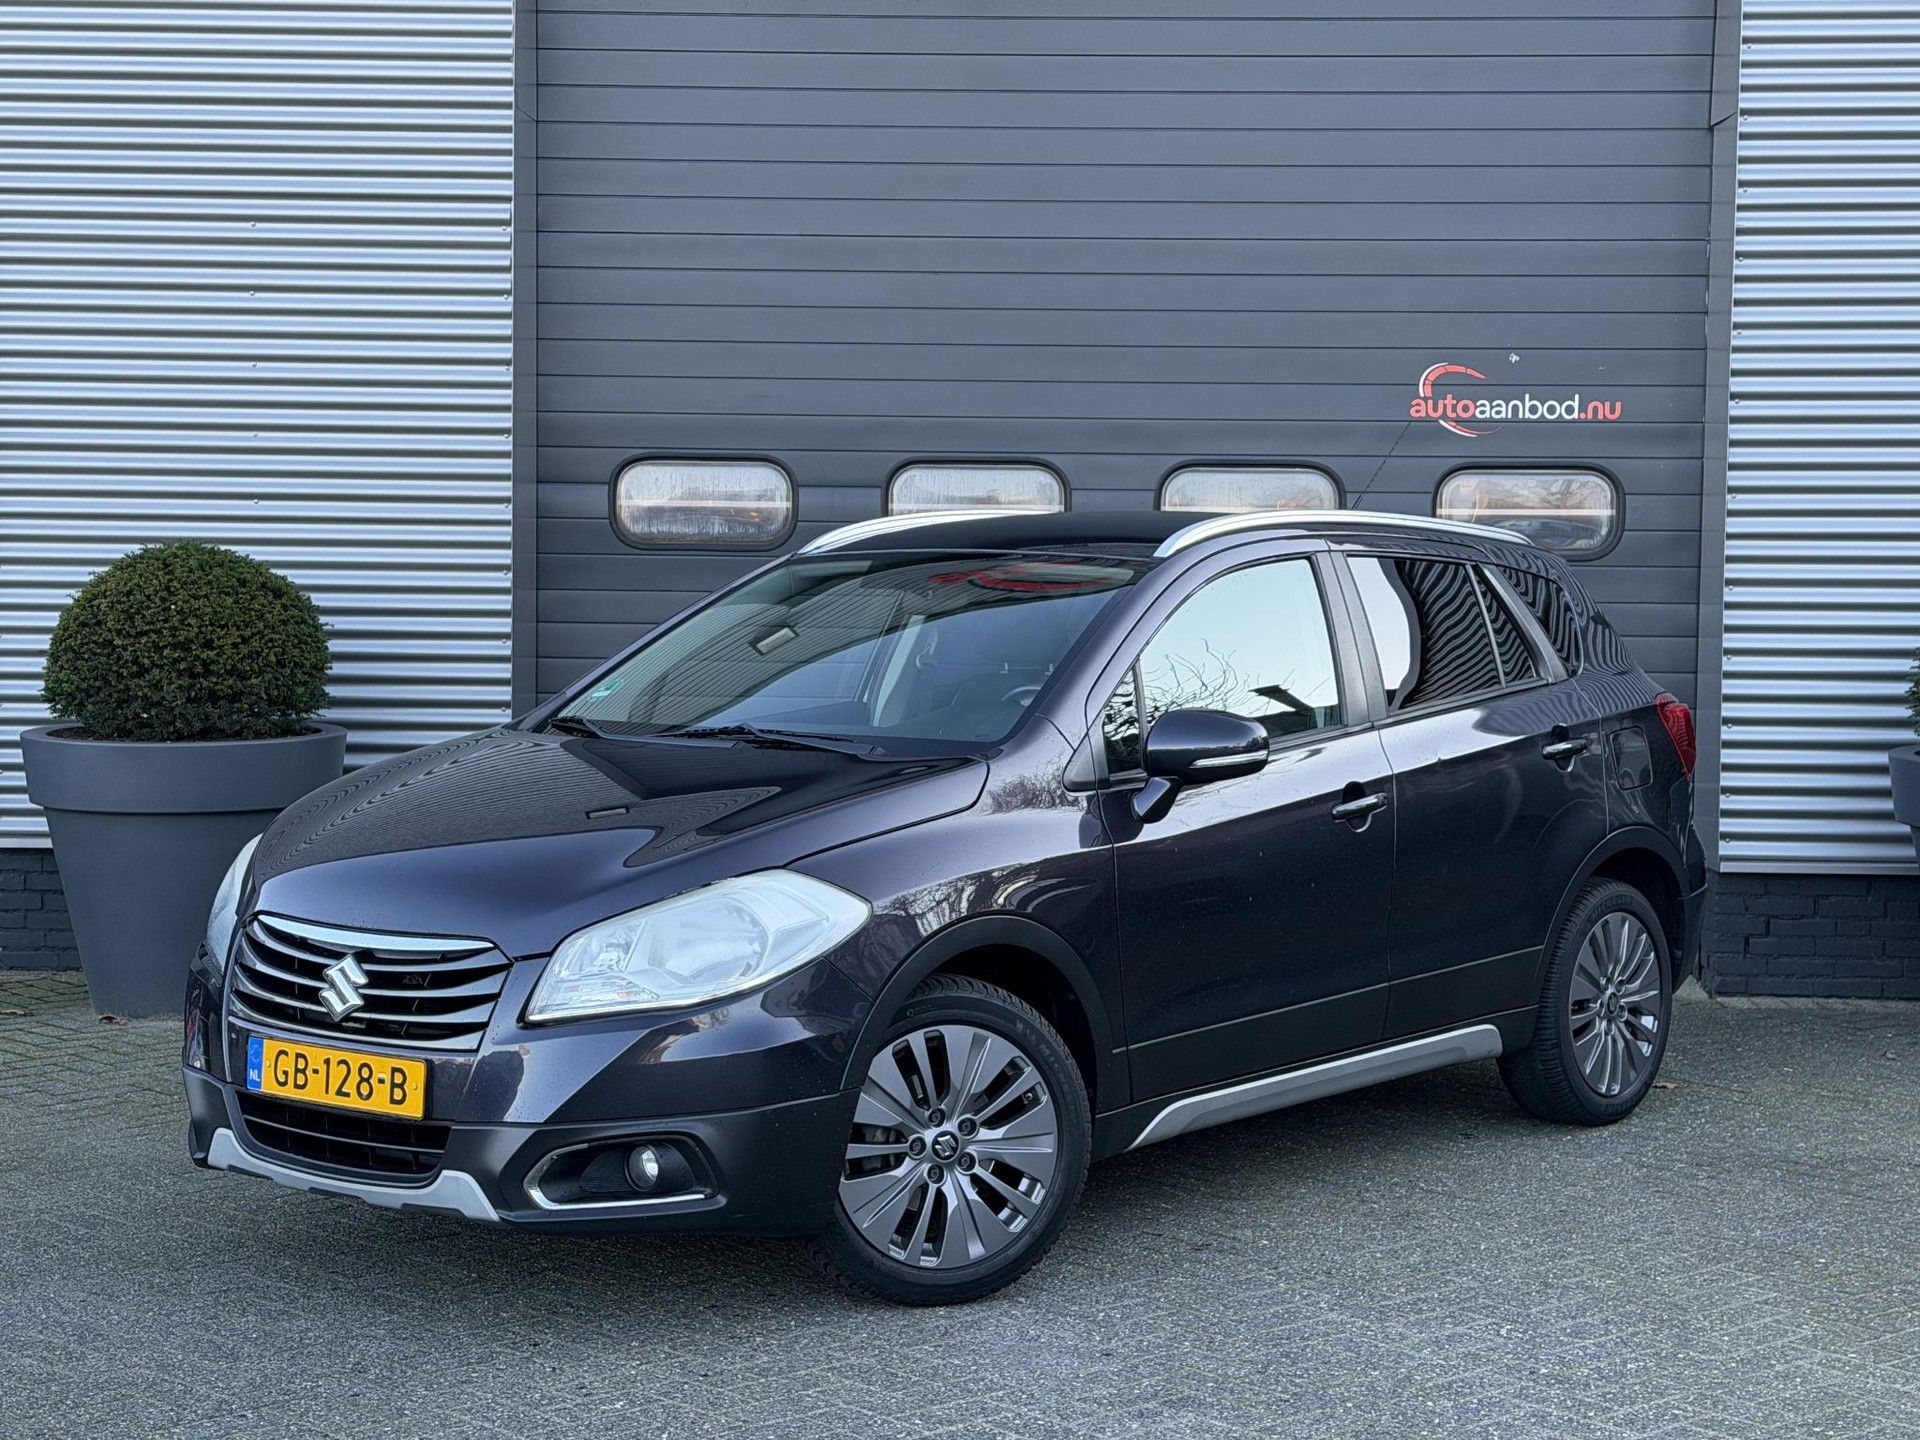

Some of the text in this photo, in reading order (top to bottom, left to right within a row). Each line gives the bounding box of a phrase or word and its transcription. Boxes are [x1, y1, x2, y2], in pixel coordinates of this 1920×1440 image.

[1409, 393, 1622, 420] autoaanbod.nu
[249, 1068, 260, 1082] NL
[273, 1049, 408, 1106] GB-128-B
